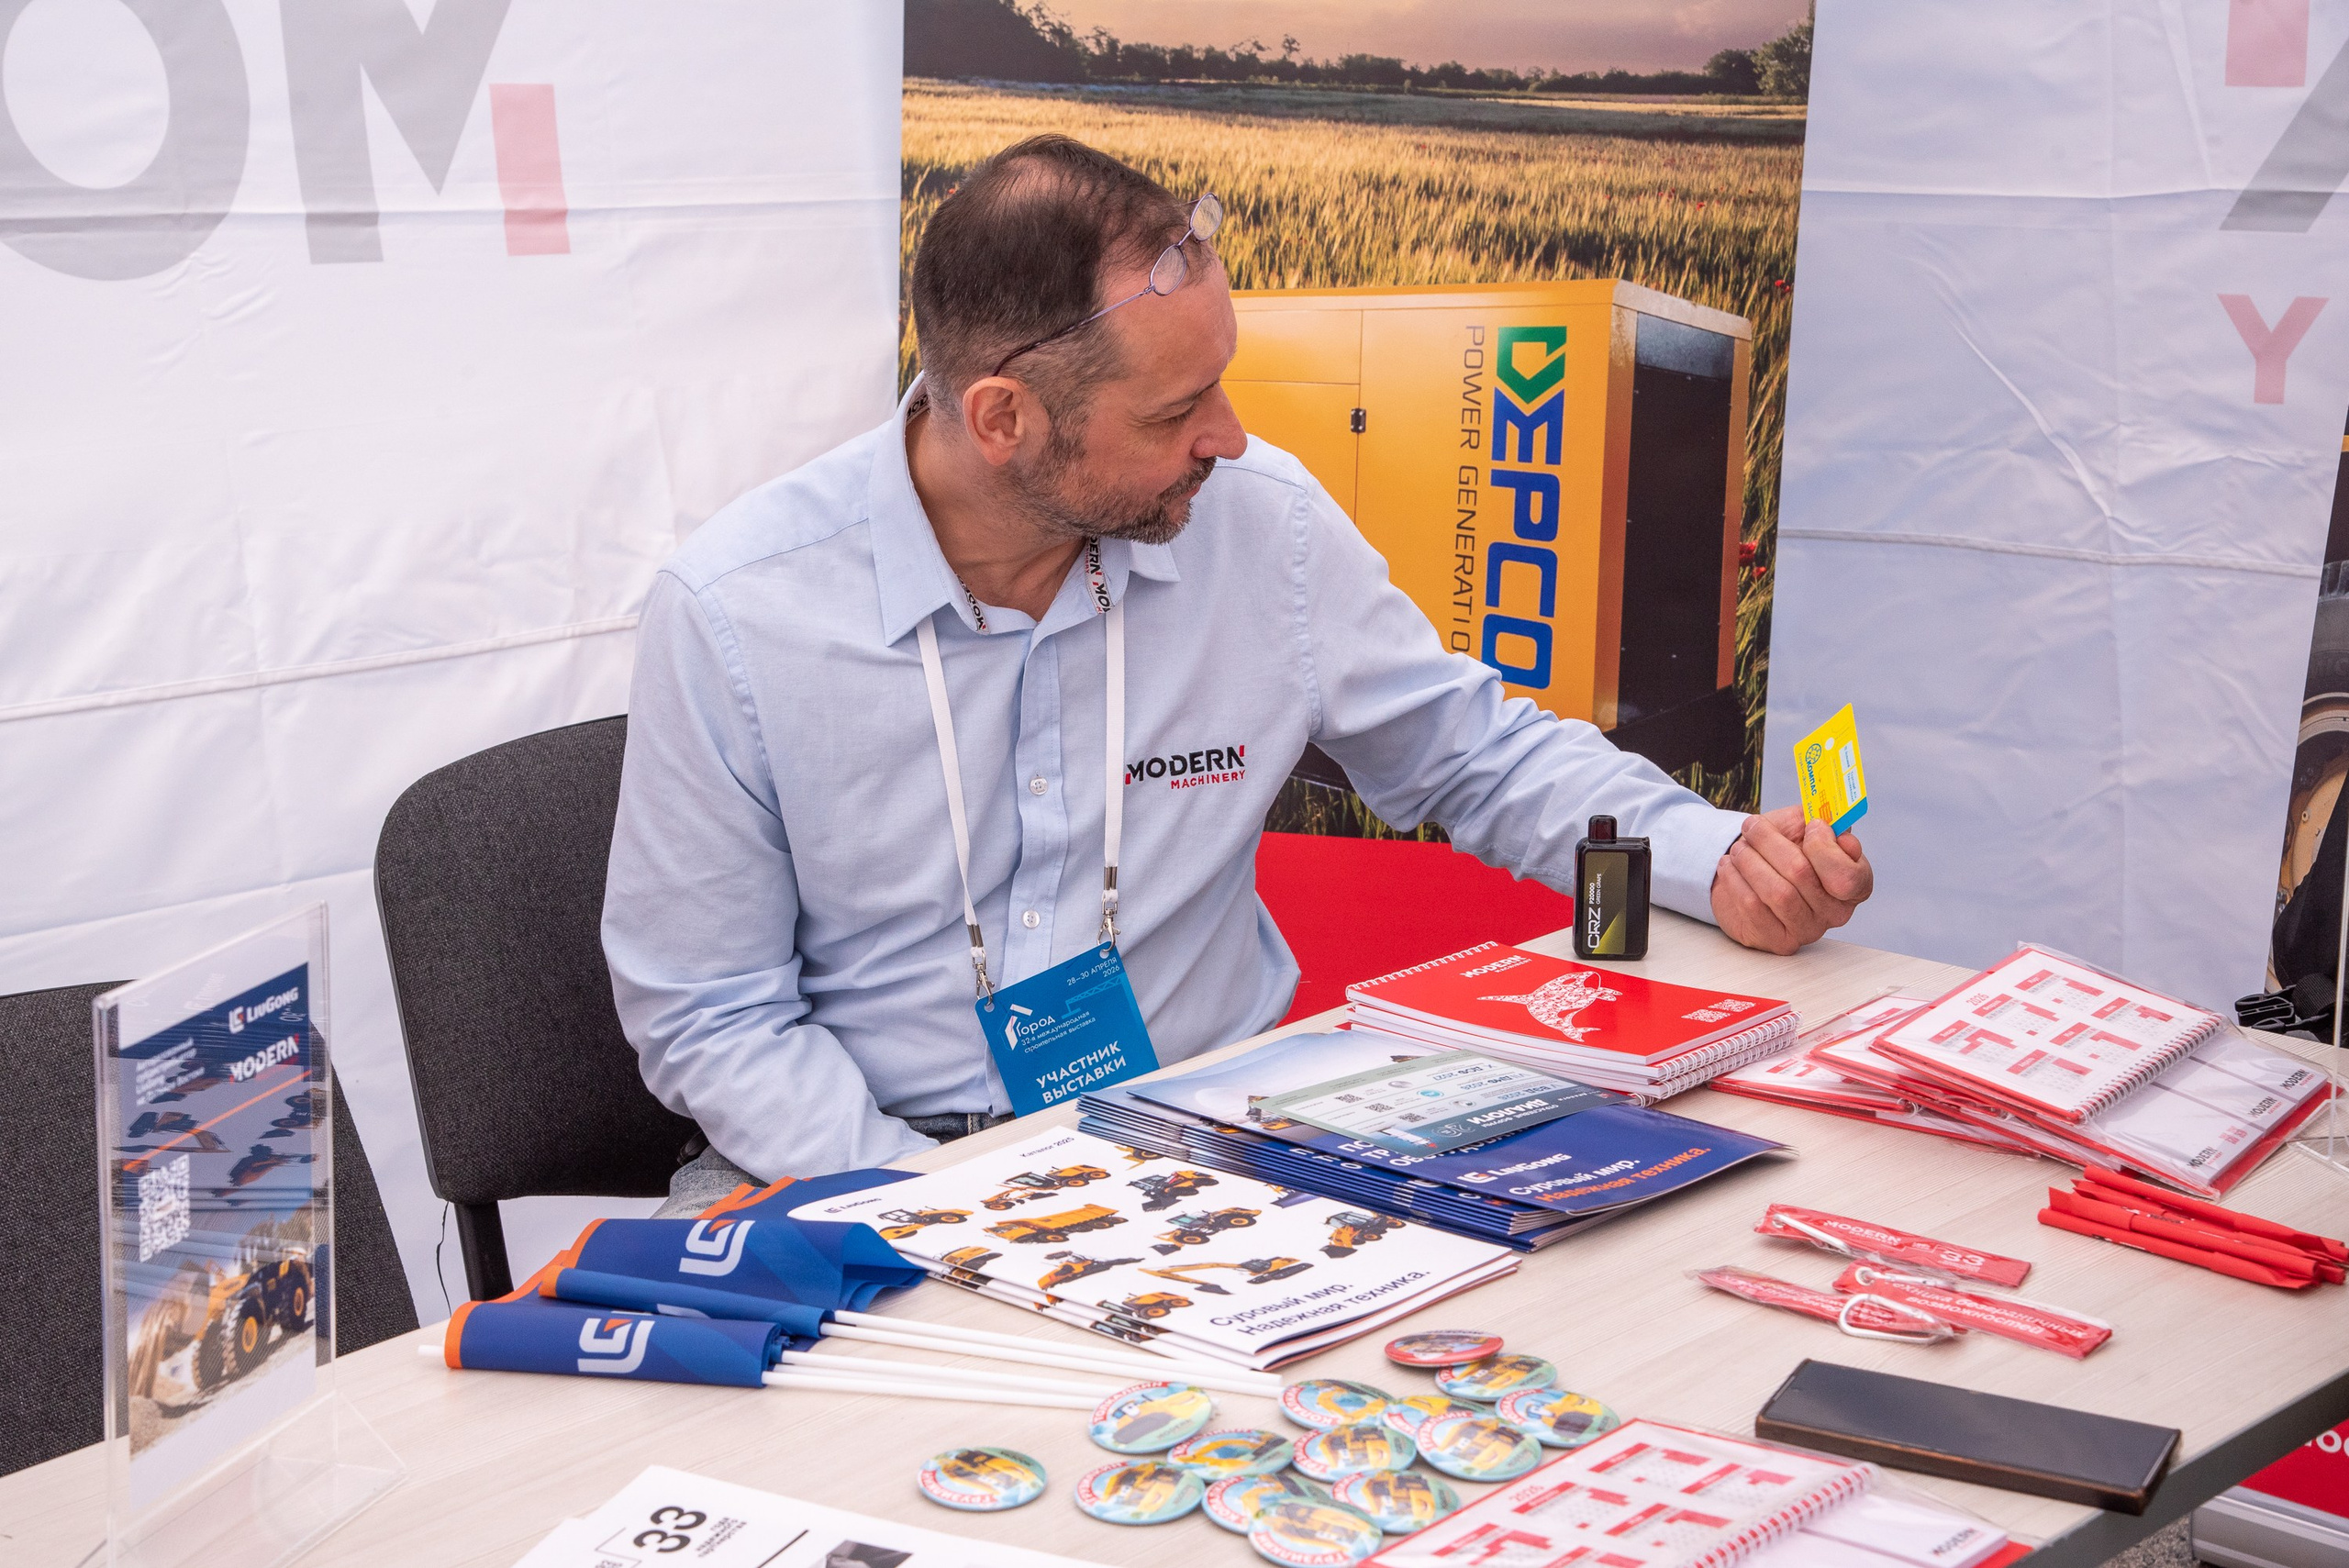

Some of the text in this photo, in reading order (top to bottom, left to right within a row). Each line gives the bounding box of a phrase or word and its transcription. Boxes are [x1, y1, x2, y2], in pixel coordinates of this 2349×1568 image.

[1460, 325, 1485, 450] POWER
[1451, 465, 1480, 652] GENERATIO
[1124, 744, 1246, 785] MODERN
[1170, 769, 1246, 790] MACHINERY
[1806, 759, 1818, 796] КОМПАС
[1587, 906, 1601, 949] CRZ
[1090, 956, 1118, 975] АПРЕЛЯ
[1103, 964, 1120, 978] 2026
[1460, 954, 1527, 978] MODERN
[1024, 1016, 1097, 1054] строительная выставка
[1036, 1010, 1090, 1040] международная
[1035, 1040, 1122, 1089] УЧАСТНИК
[1041, 1056, 1127, 1105] ВЫСТАВКИ
[1465, 1097, 1550, 1126] ДИАЛОГИ
[1019, 1144, 1053, 1158] Каталог
[1508, 1158, 1640, 1197] Суровый мир.
[1534, 1175, 1635, 1205] Надежная
[1633, 1147, 1712, 1181] техника.
[1823, 1218, 1902, 1243] MODERN
[1940, 1249, 1986, 1267] 33
[1209, 1282, 1354, 1328] Суровый мир.
[1237, 1270, 1431, 1338] Надежная техника.
[1884, 1278, 1953, 1303] ехника
[1905, 1296, 2044, 1335] возможностей
[633, 1505, 707, 1554] 33
